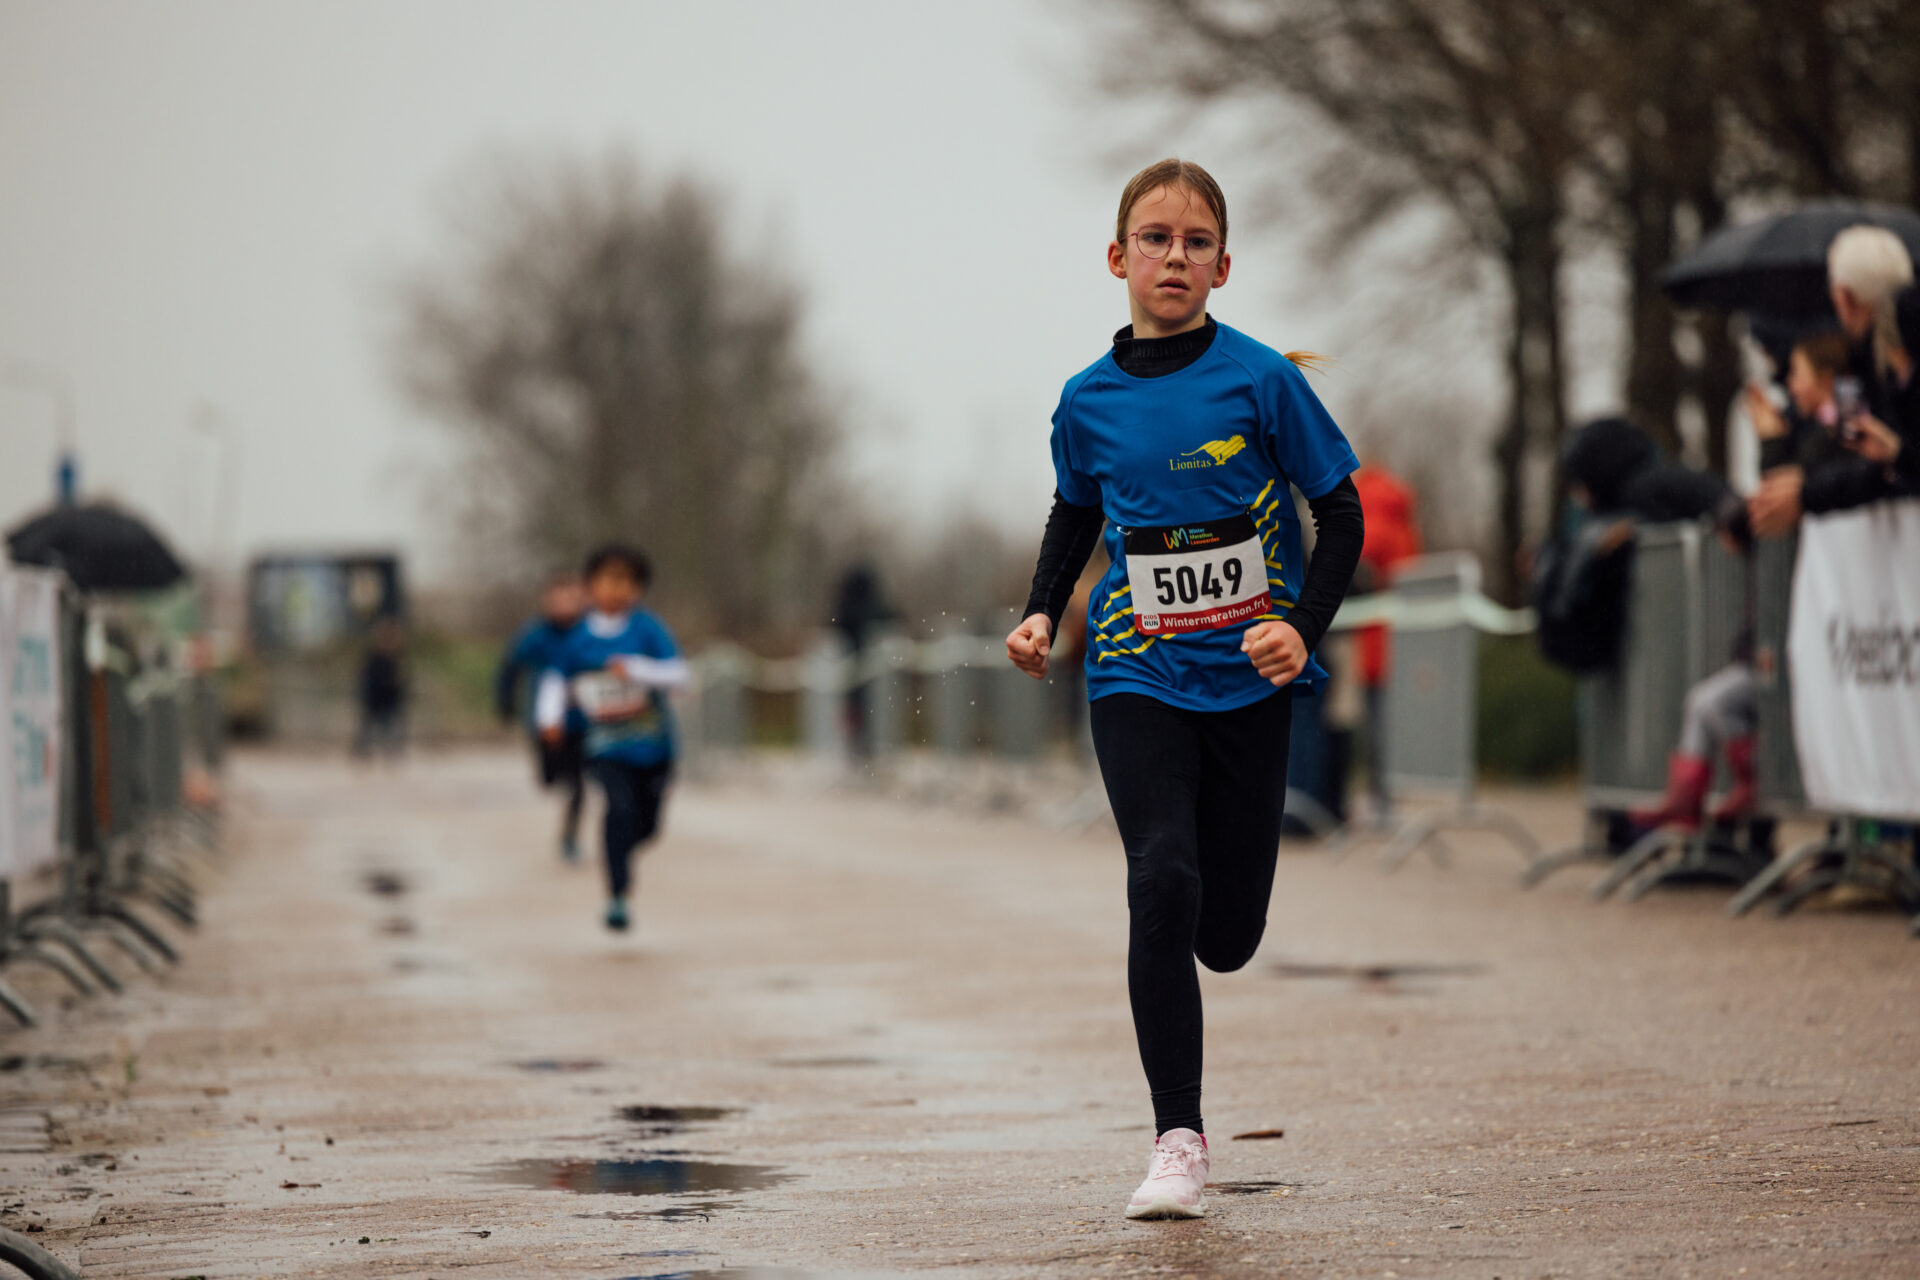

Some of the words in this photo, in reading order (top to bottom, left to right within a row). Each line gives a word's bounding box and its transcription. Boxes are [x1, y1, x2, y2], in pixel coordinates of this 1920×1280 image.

[1169, 458, 1212, 471] Lionitas
[1189, 532, 1214, 540] Marathon
[1153, 557, 1242, 606] 5049
[1163, 597, 1266, 628] Wintermarathon.frl
